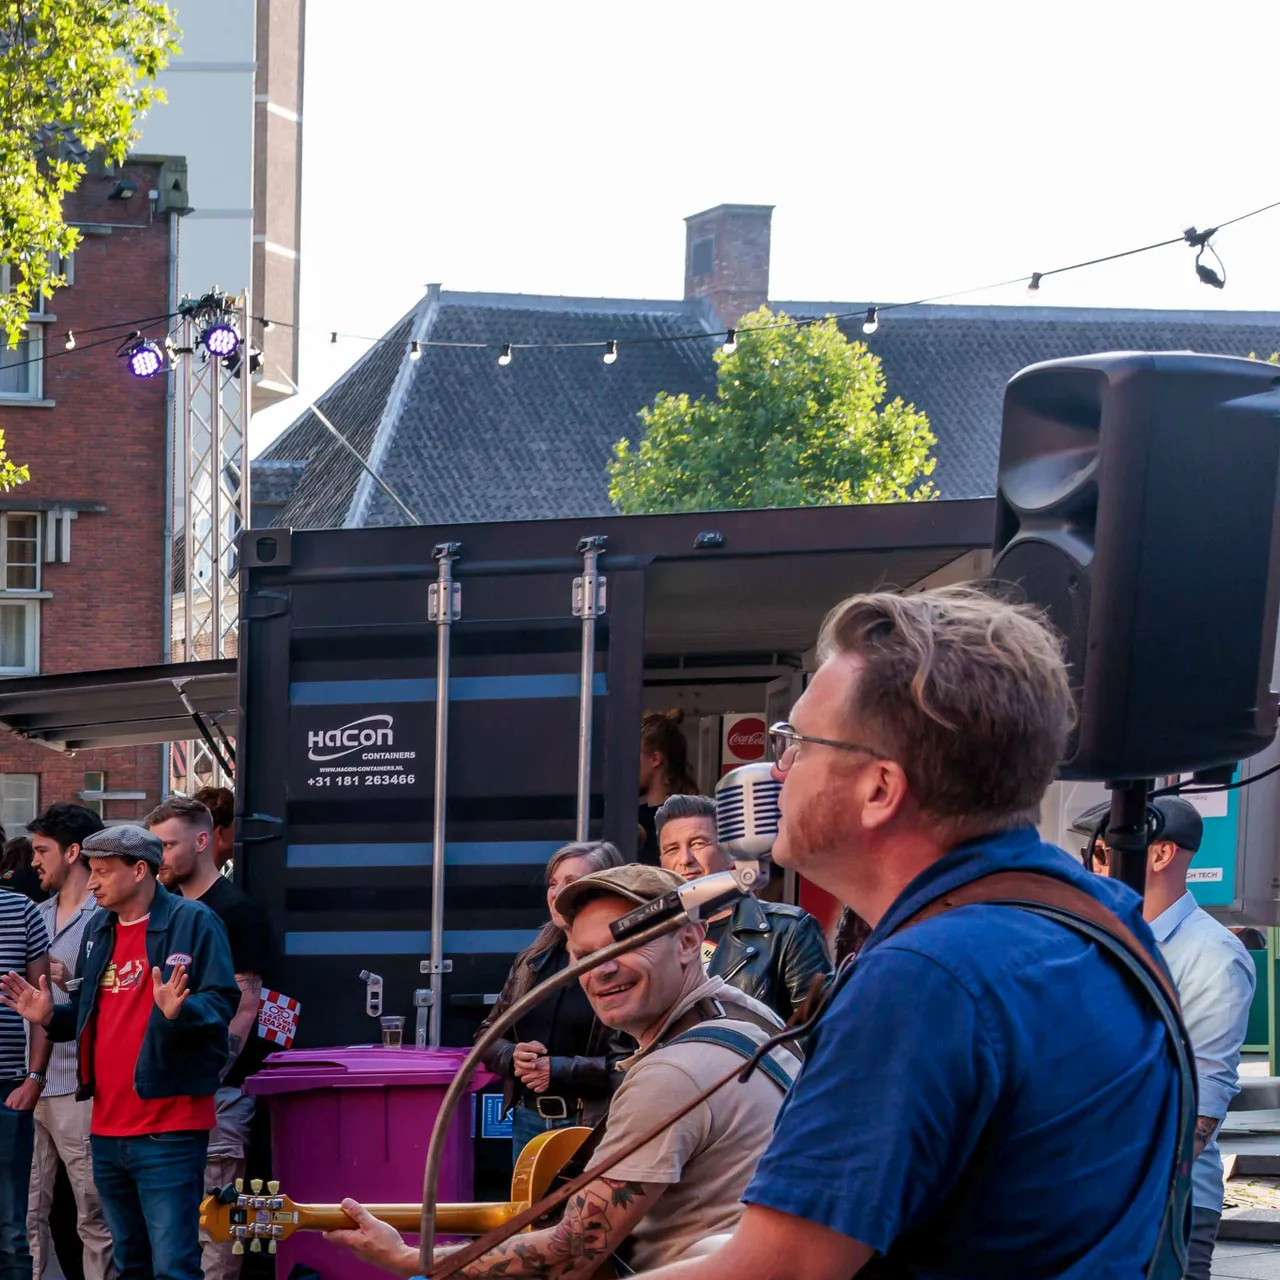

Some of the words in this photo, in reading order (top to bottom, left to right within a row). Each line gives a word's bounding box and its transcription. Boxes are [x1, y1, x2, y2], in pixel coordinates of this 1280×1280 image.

[362, 752, 416, 760] CONTAINERS
[308, 776, 331, 786] +31
[336, 776, 359, 786] 181
[365, 774, 416, 785] 263466
